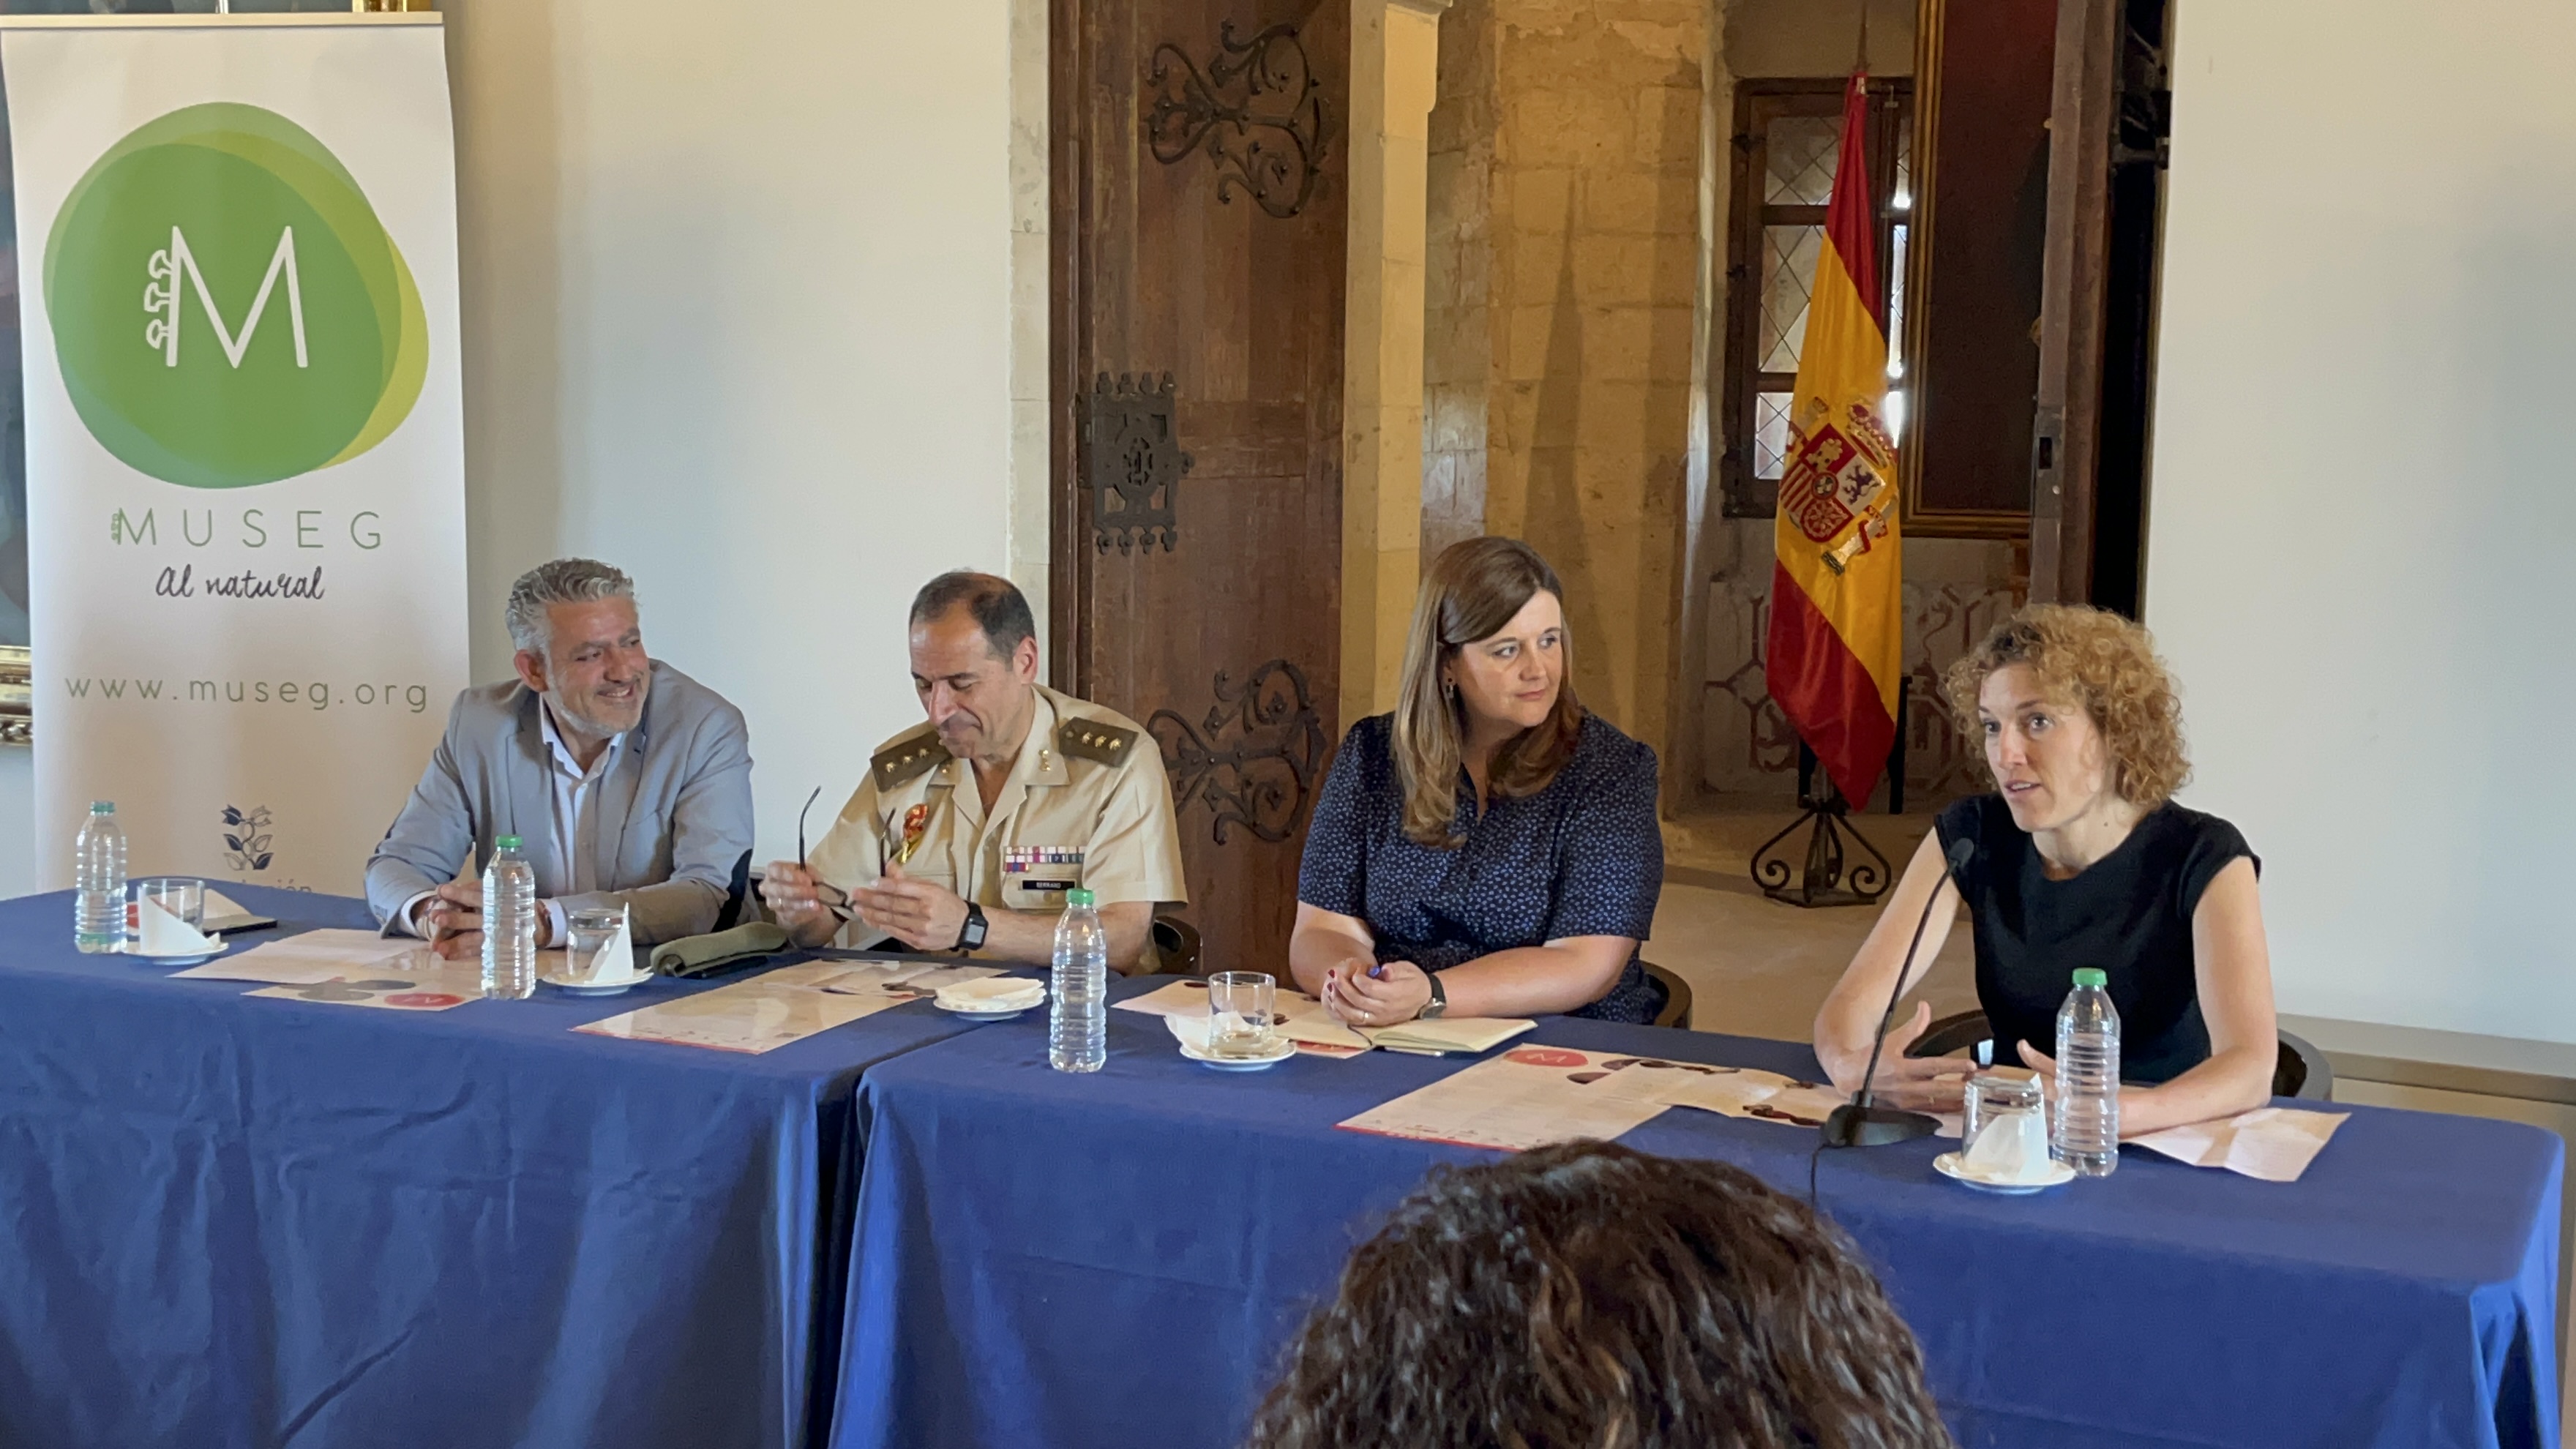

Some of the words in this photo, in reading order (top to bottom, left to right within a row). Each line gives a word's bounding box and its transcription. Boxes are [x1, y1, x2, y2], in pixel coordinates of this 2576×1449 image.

[155, 225, 309, 369] M
[112, 507, 381, 550] MUSEG
[206, 566, 326, 600] natural
[64, 678, 428, 714] www.museg.org
